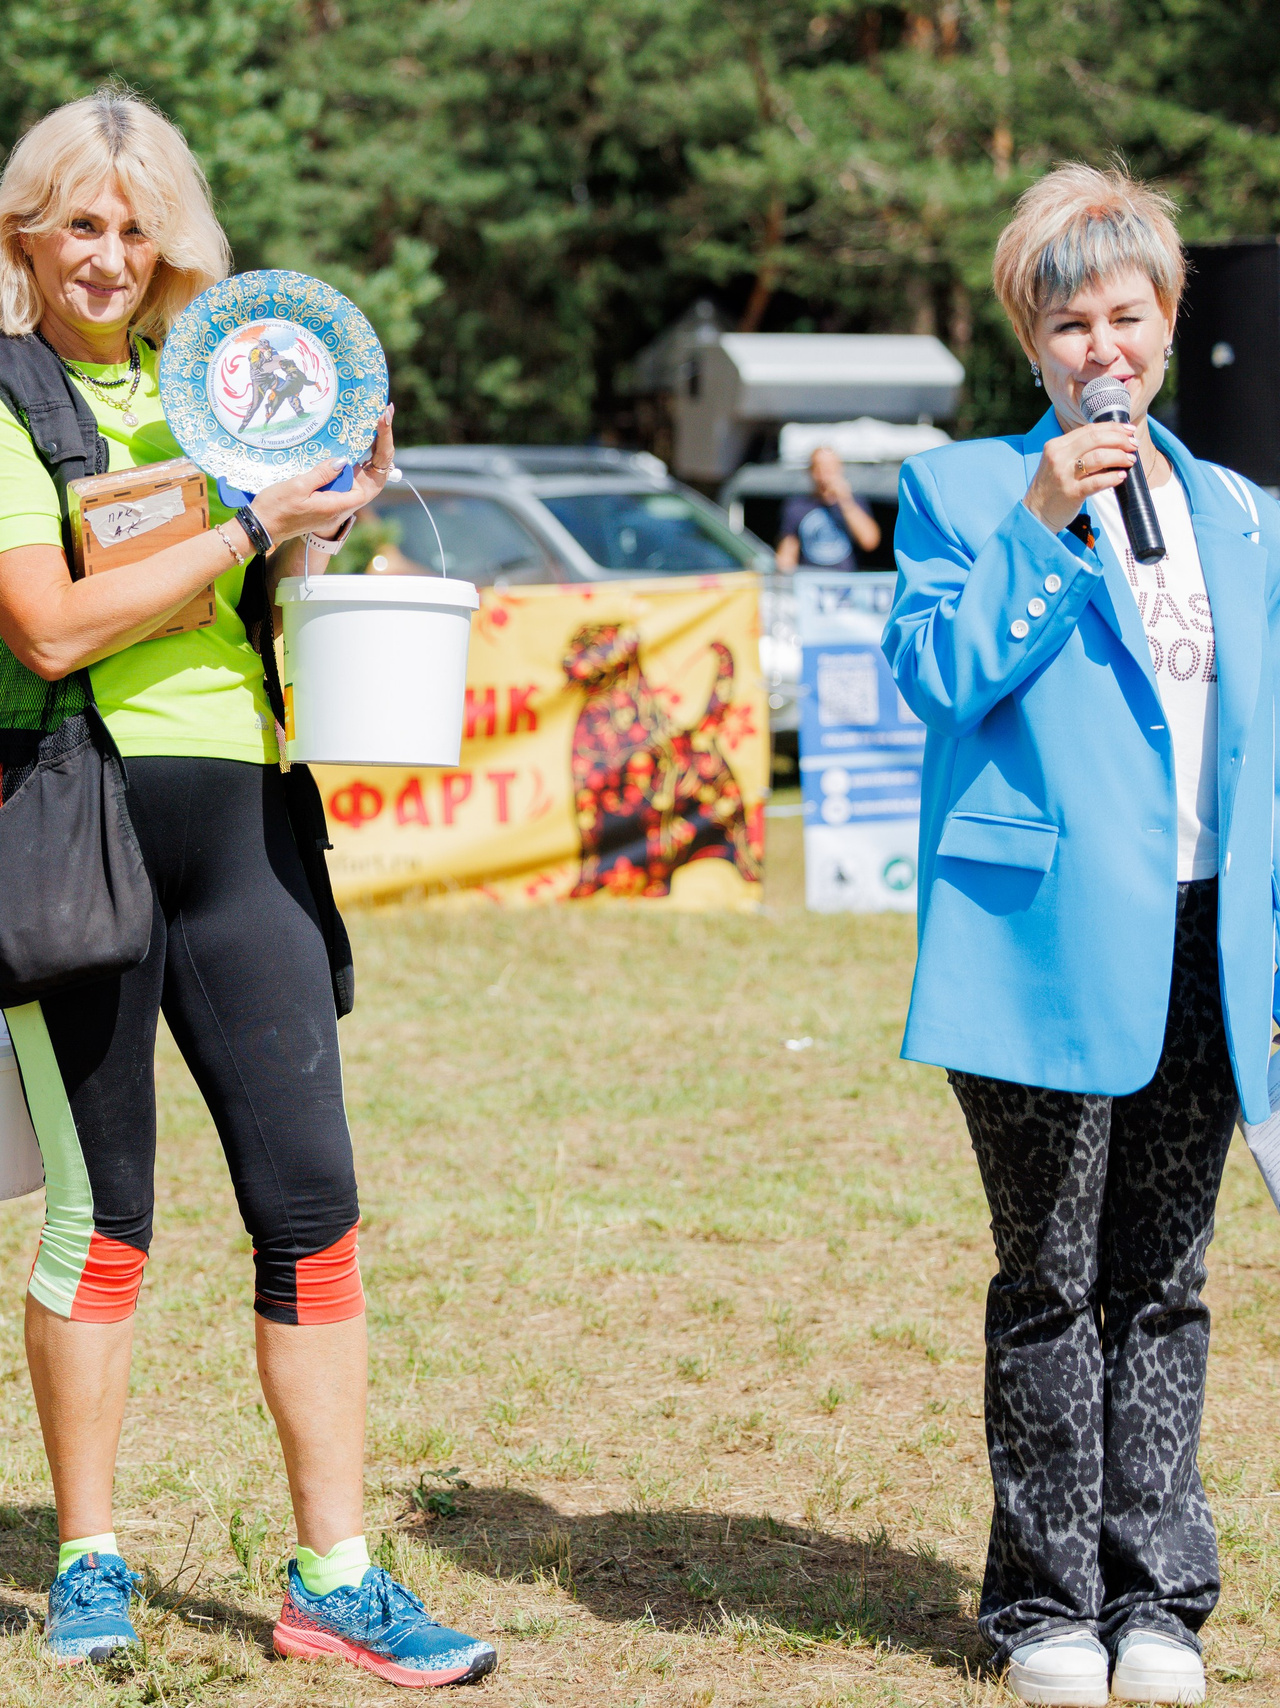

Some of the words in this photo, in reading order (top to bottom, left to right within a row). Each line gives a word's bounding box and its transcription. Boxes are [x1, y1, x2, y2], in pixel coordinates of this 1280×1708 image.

[286, 433, 307, 444] собака
[305, 420, 319, 433] ПРК
[328, 770, 517, 829] ФАРТ
